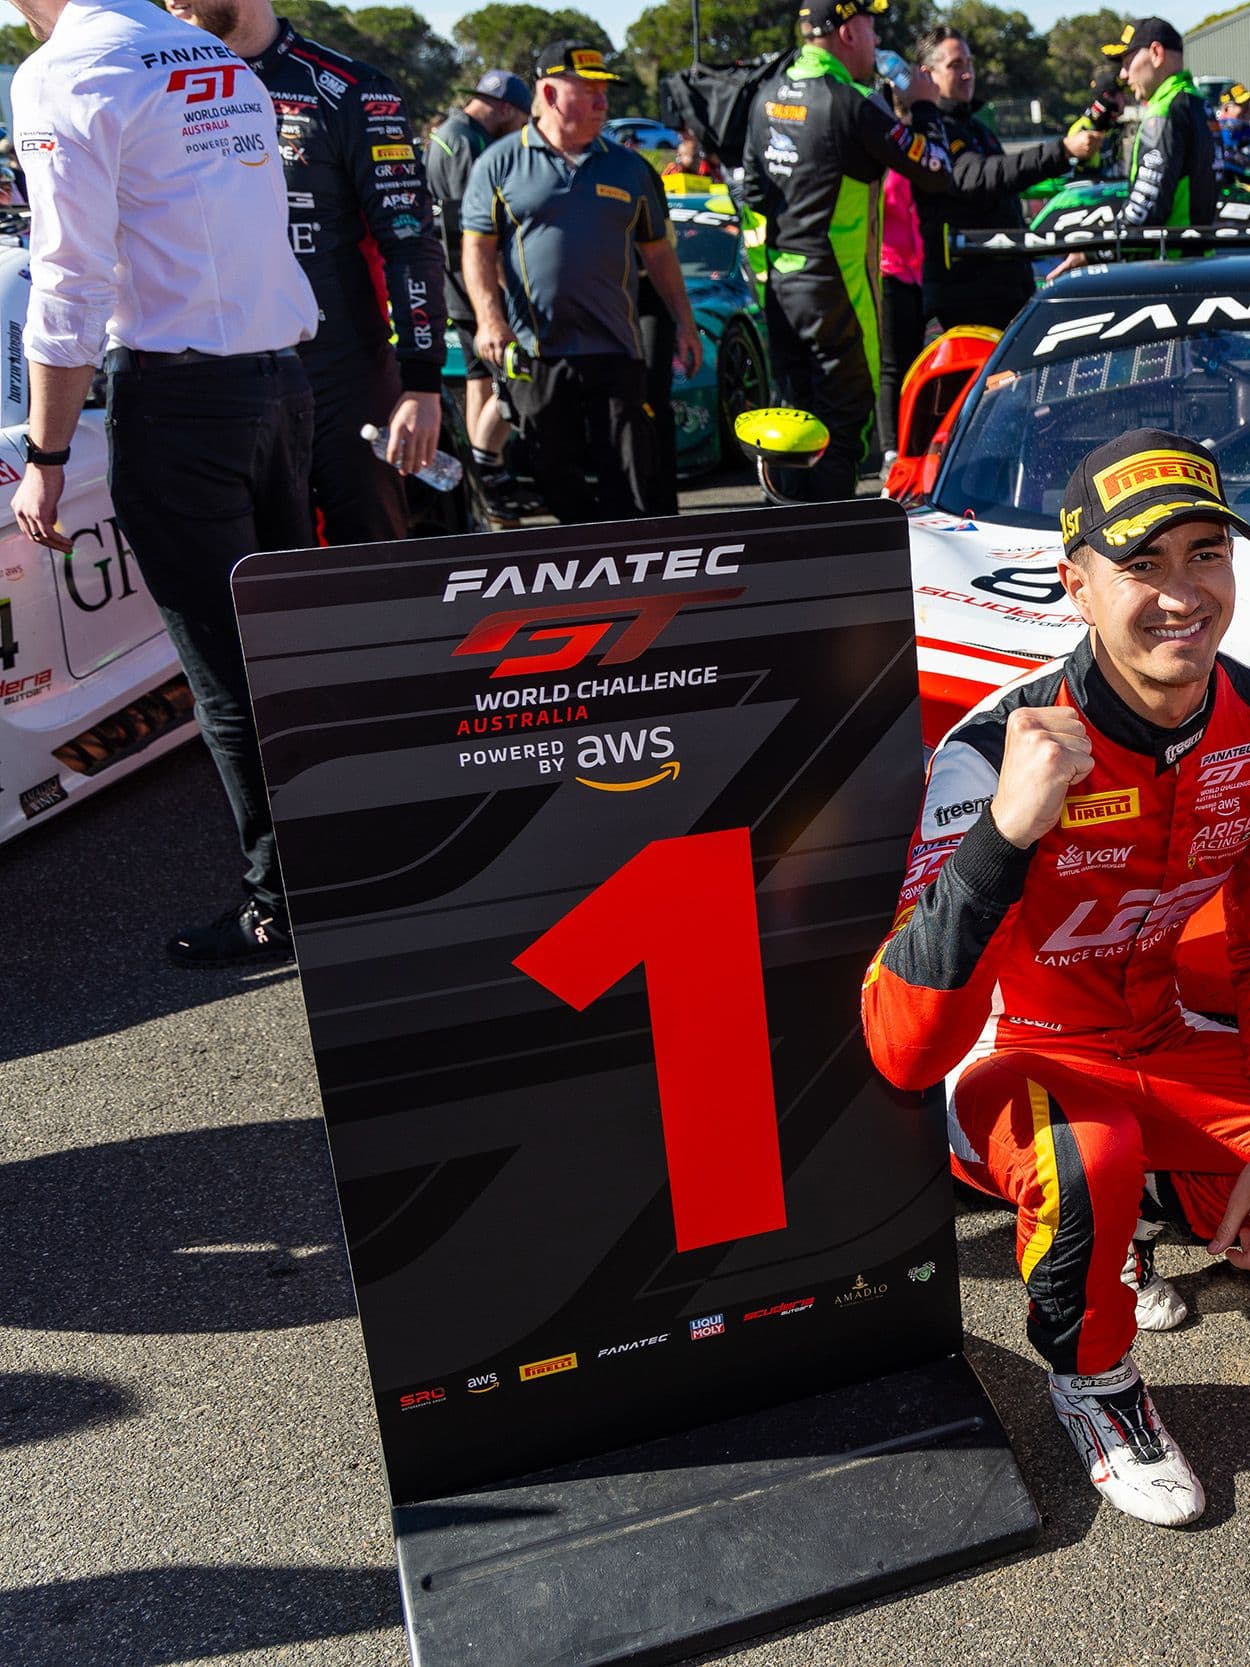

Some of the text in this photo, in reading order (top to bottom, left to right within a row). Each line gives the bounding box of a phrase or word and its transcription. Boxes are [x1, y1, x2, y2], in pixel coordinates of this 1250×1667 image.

[141, 46, 238, 69] FANATEC
[319, 74, 346, 95] OMP
[184, 103, 262, 123] WORLD CHALLENGE
[182, 120, 230, 137] AUSTRALIA
[186, 138, 230, 154] POWERED
[233, 134, 265, 154] aws
[375, 164, 416, 178] GROVE
[407, 279, 432, 350] GROVE
[1103, 456, 1213, 500] PIRELLI
[1060, 505, 1083, 545] 1ST
[443, 544, 745, 602] FANATEC
[451, 587, 748, 679] GT
[475, 666, 718, 711] WORLD CHALLENGE
[457, 705, 588, 735] AUSTRALIA
[460, 741, 564, 767] POWERED
[576, 726, 674, 769] aws
[1165, 730, 1203, 764] freem
[539, 758, 564, 774] BY
[1067, 796, 1131, 822] PIRELLI
[1218, 797, 1240, 810] aws
[1086, 845, 1134, 865] VGW
[1190, 834, 1241, 855] RACING
[1035, 950, 1090, 967] LANCE
[1095, 939, 1135, 958] EAST
[513, 826, 789, 1254] 1
[834, 1283, 888, 1305] AMADIO
[743, 1297, 815, 1321] scuderia
[692, 1314, 722, 1330] LIQUI
[692, 1324, 723, 1339] MOLY
[597, 1333, 669, 1358] FANATEC
[523, 1356, 573, 1378] PIRELLI
[467, 1372, 498, 1388] aws
[400, 1387, 445, 1408] SRO
